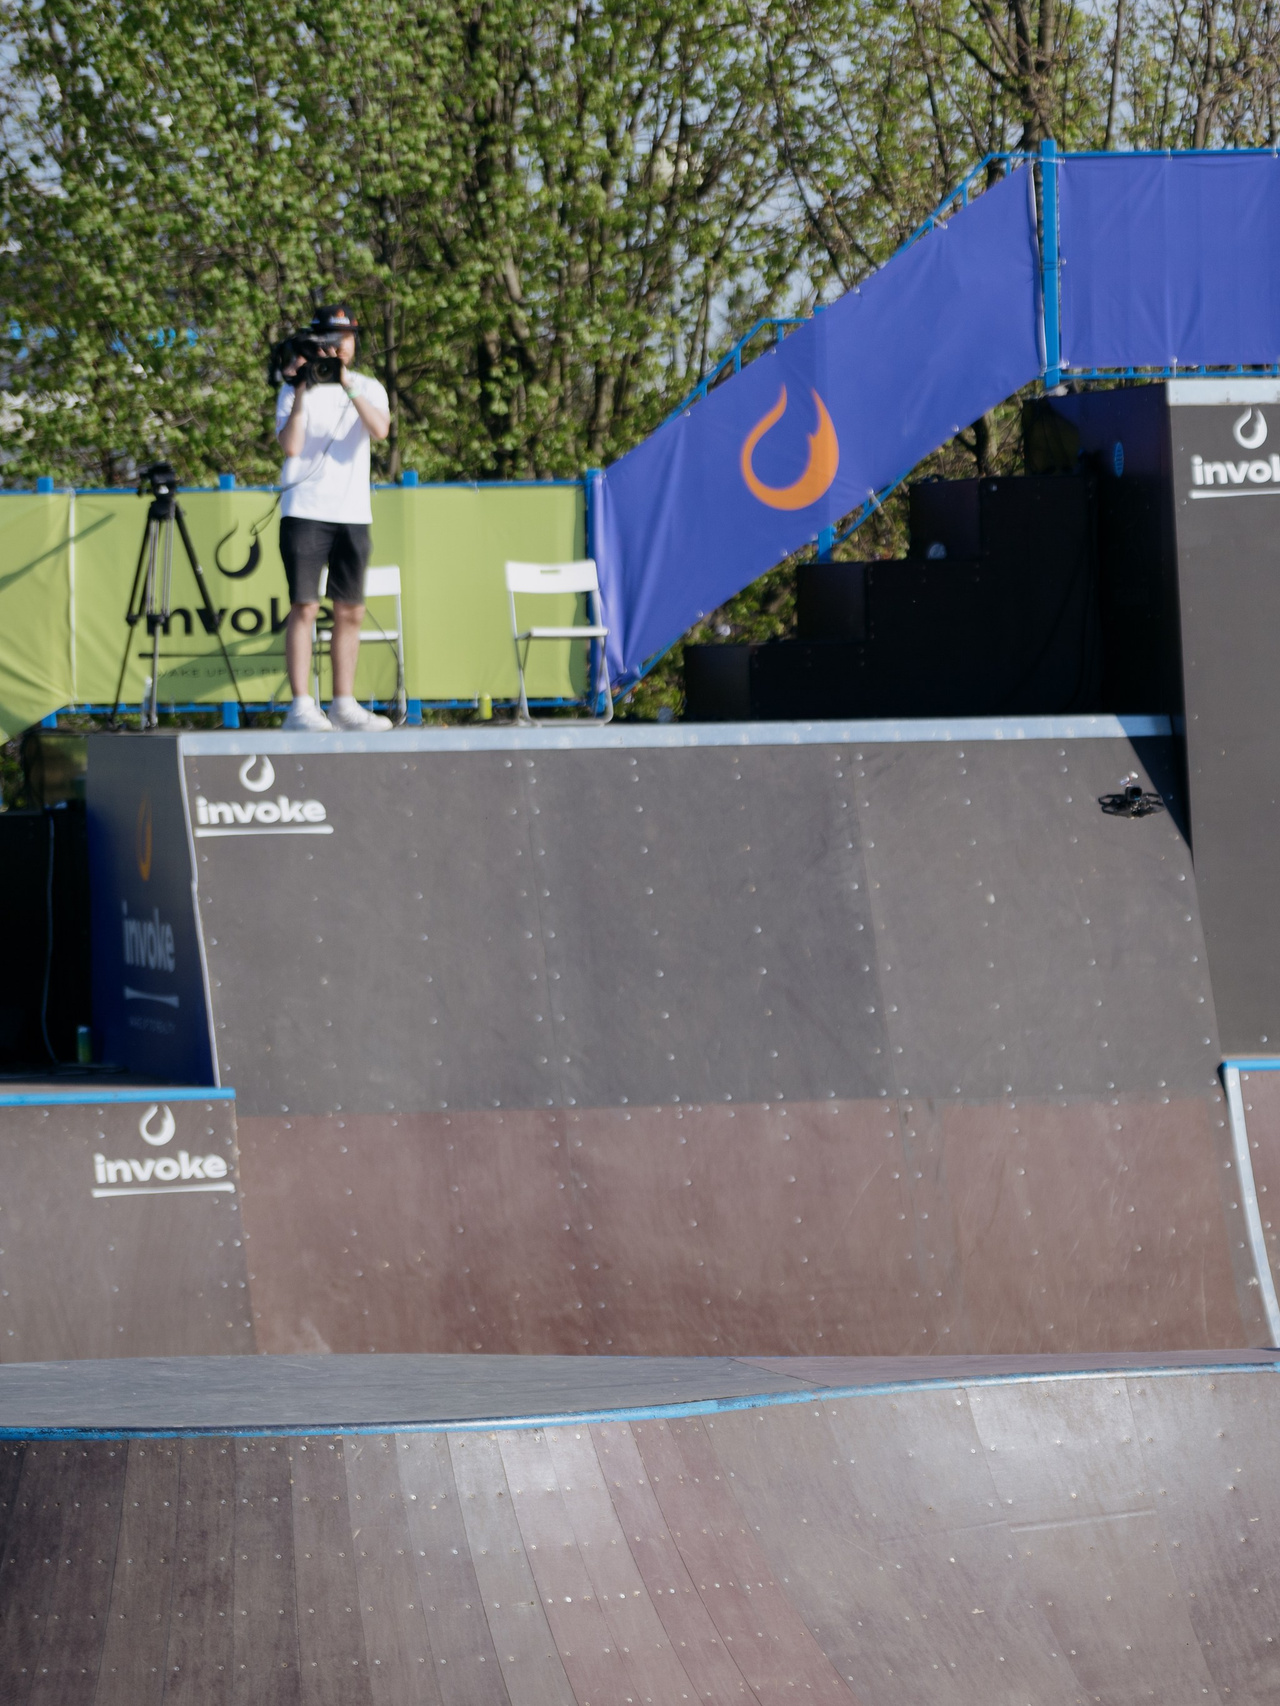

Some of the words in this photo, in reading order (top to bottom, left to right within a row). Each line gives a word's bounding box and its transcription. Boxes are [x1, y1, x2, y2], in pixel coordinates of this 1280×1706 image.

[195, 795, 327, 825] invoke
[122, 900, 176, 973] invoke
[94, 1150, 229, 1185] invoke
